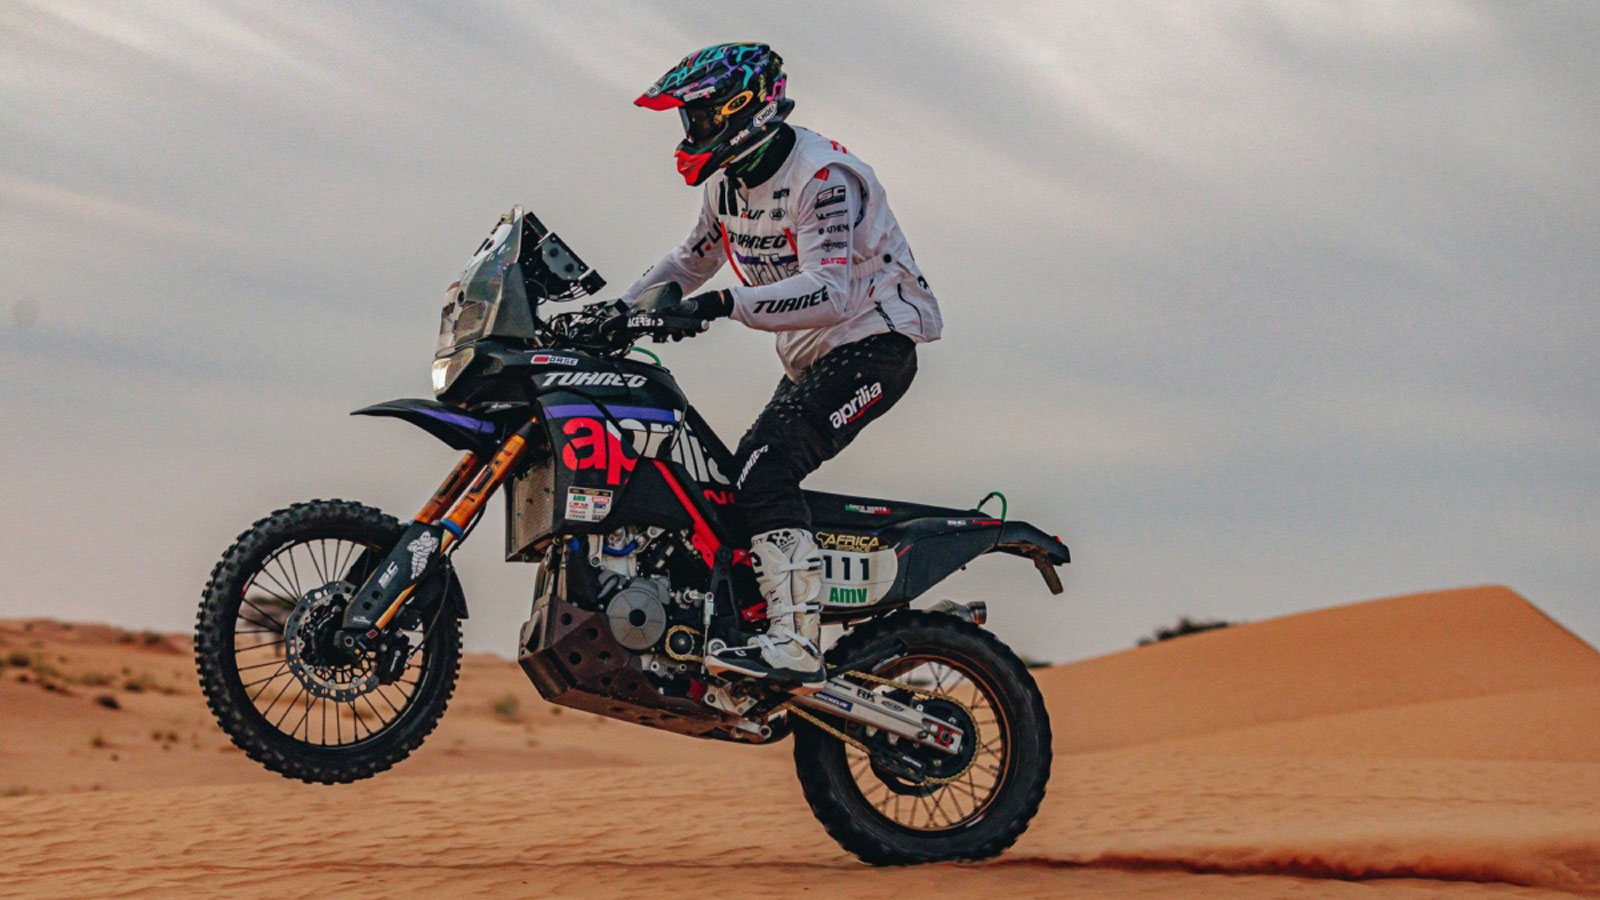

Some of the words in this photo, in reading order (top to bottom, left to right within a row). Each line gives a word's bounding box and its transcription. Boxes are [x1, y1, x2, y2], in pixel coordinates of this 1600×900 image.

[542, 371, 648, 388] TUAREG
[829, 381, 882, 429] aprilia
[824, 533, 879, 549] AFRICA
[823, 555, 869, 581] 111
[857, 689, 875, 703] RK
